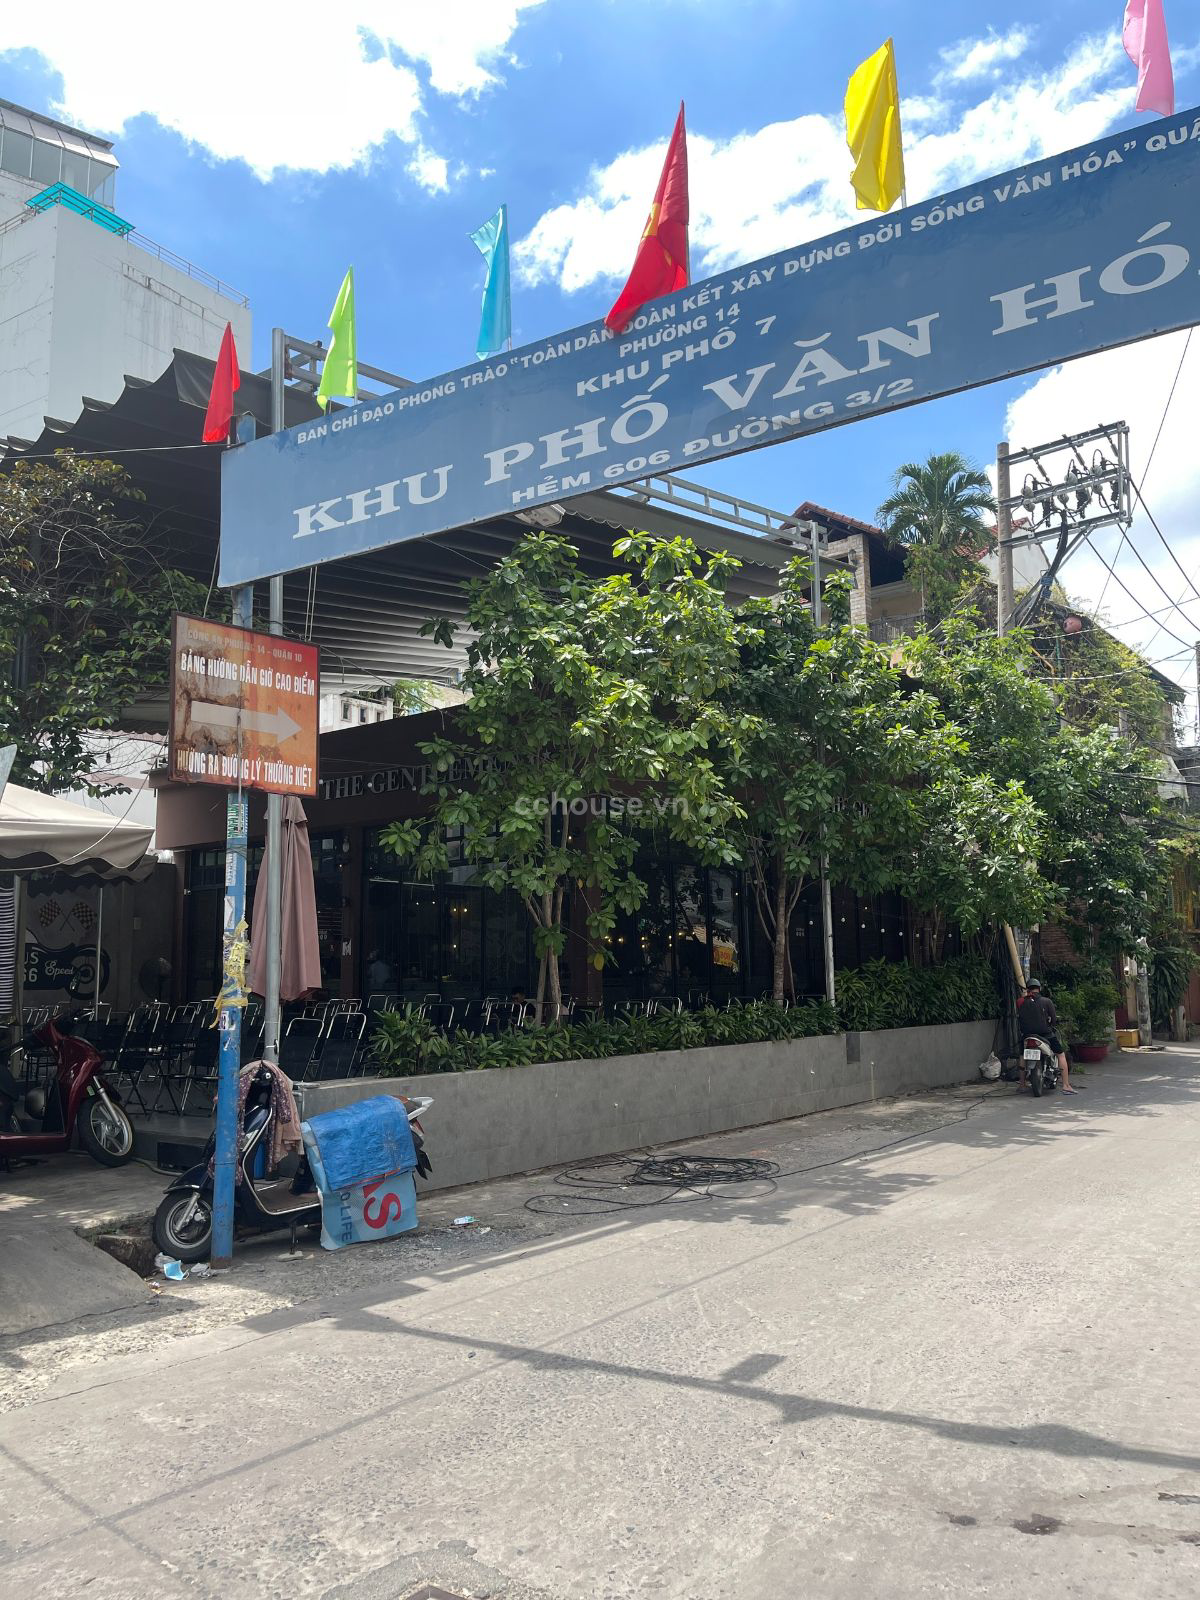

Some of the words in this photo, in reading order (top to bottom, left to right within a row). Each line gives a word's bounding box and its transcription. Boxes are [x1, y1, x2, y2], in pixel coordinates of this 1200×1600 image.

[297, 425, 327, 444] BAN
[331, 408, 358, 433] CHỈ
[362, 402, 395, 422] ĐẠO
[399, 381, 456, 410] PHONG
[461, 364, 508, 389] TRÀO
[574, 327, 614, 351] DÂN
[683, 284, 724, 312] KẾT
[731, 266, 777, 295] XÂY
[784, 241, 851, 278] DỰNG
[858, 223, 902, 250] ĐỜI
[911, 195, 985, 232] SỐNG
[992, 171, 1052, 203] VĂN
[619, 315, 707, 358] PHƯỜNG
[715, 303, 740, 321] 14
[292, 464, 453, 540] KHU
[483, 373, 670, 486] PHỐ
[702, 312, 940, 411] VĂN
[989, 221, 1200, 336] HÓ
[576, 360, 649, 397] KHU
[662, 318, 741, 370] PHỐ
[755, 315, 777, 336] 7
[512, 471, 591, 504] HẺM
[603, 450, 671, 478] 606
[682, 401, 835, 457] ĐƯỜNG
[845, 378, 914, 408] 3/2
[181, 648, 206, 675] BẢNG
[207, 657, 237, 681] HƯỚNG
[240, 660, 258, 685] DẪN
[260, 667, 274, 688] GIỜ
[275, 672, 291, 692] CAO
[294, 671, 315, 696] ĐIỂM
[294, 653, 303, 662] 10
[208, 753, 219, 776] RA
[250, 757, 262, 781] LÝ
[264, 760, 293, 785] THƯỜNG
[295, 764, 312, 790] KIỆT
[323, 775, 364, 801] THE
[45, 960, 74, 981] Speed
